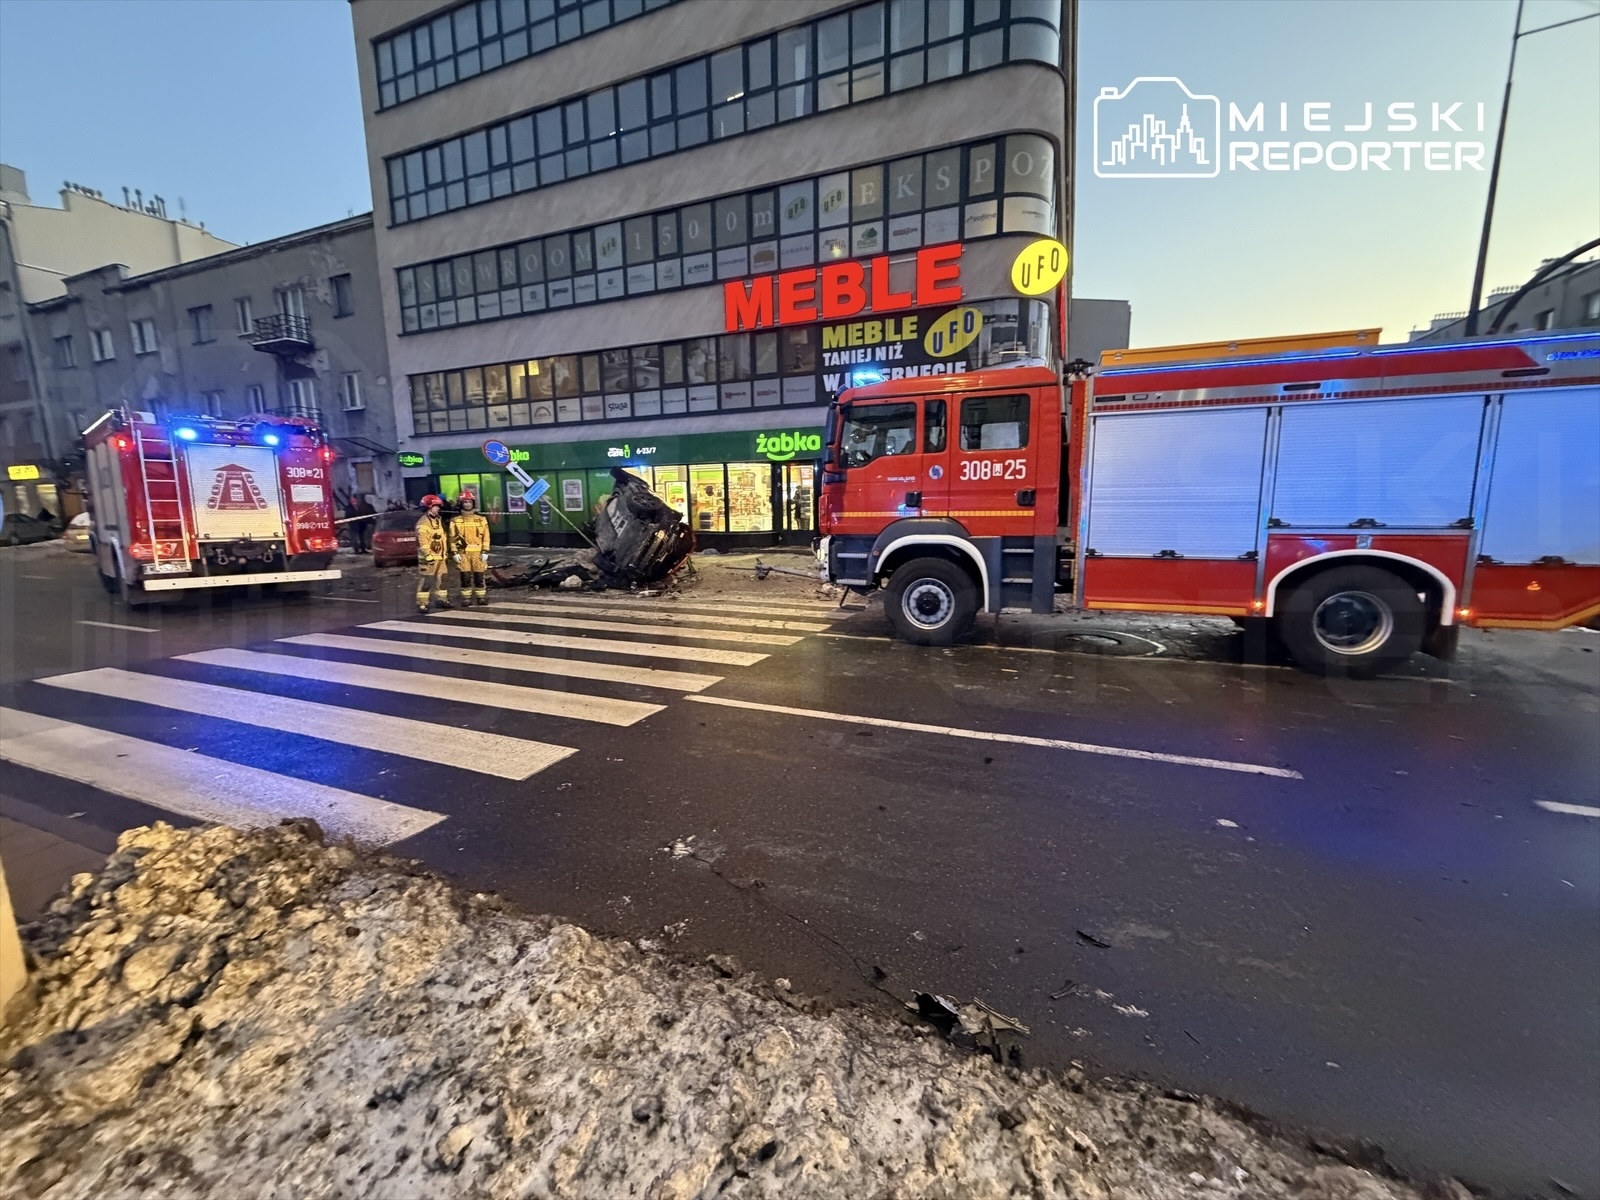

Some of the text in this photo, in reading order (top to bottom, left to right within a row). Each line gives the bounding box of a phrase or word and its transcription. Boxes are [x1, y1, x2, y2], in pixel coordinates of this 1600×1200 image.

[421, 243, 592, 293] SHOWROOM
[1021, 246, 1061, 289] UFO
[724, 243, 962, 332] MEBLE
[822, 315, 918, 350] MEBLE
[932, 310, 976, 354] UFO
[822, 342, 904, 367] TANIEJ NIŻ
[822, 372, 842, 392] W
[509, 449, 530, 461] bka
[756, 432, 821, 454] żabka
[399, 455, 424, 464] żabka
[959, 459, 992, 481] 308
[1003, 458, 1027, 480] 25
